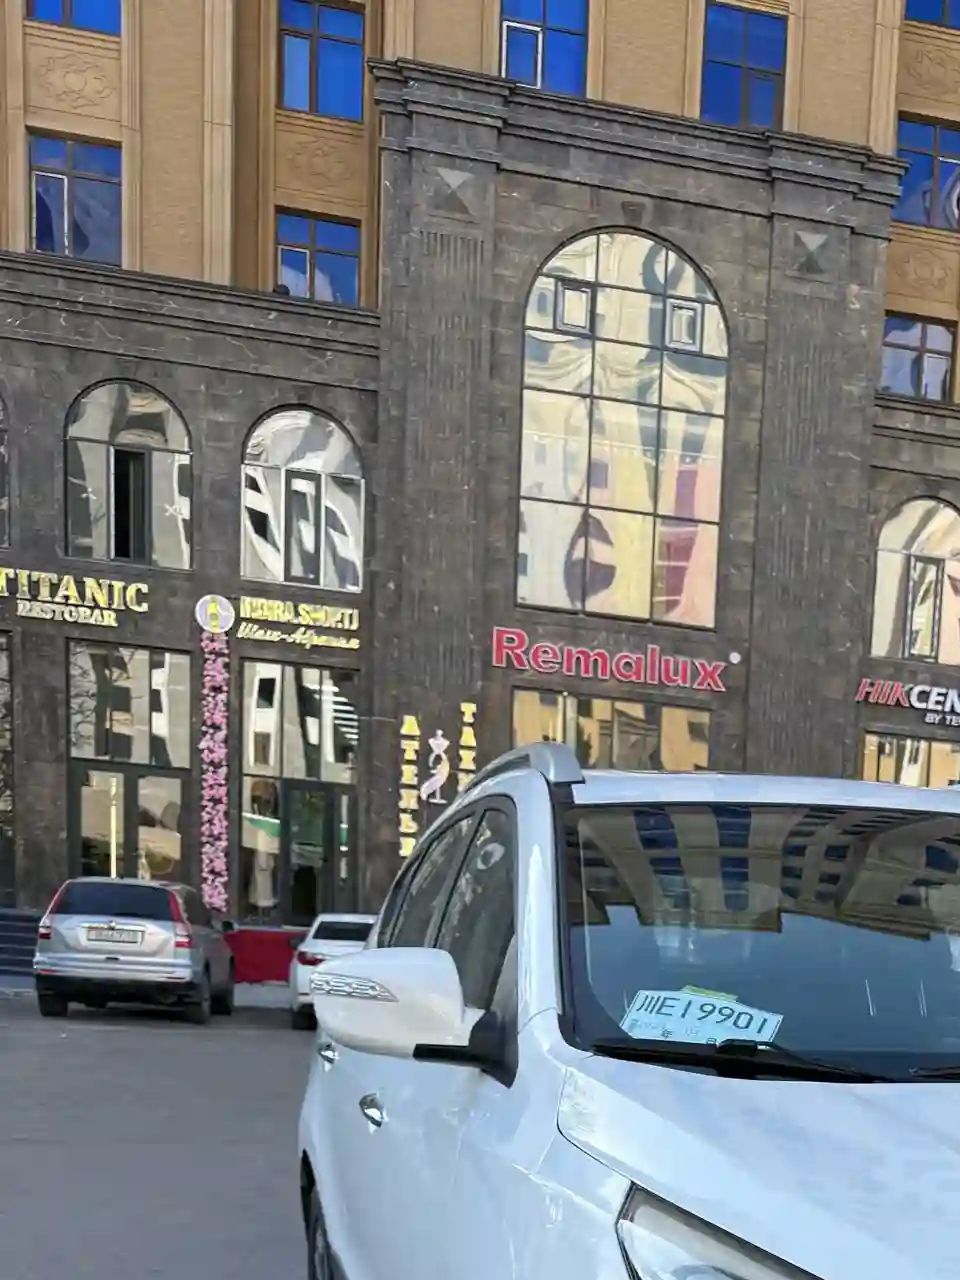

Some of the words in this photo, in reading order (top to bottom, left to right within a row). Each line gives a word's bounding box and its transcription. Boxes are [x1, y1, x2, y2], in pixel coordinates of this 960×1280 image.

[0, 567, 149, 613] TITANIC
[492, 626, 727, 691] Remalux
[924, 712, 941, 724] BY
